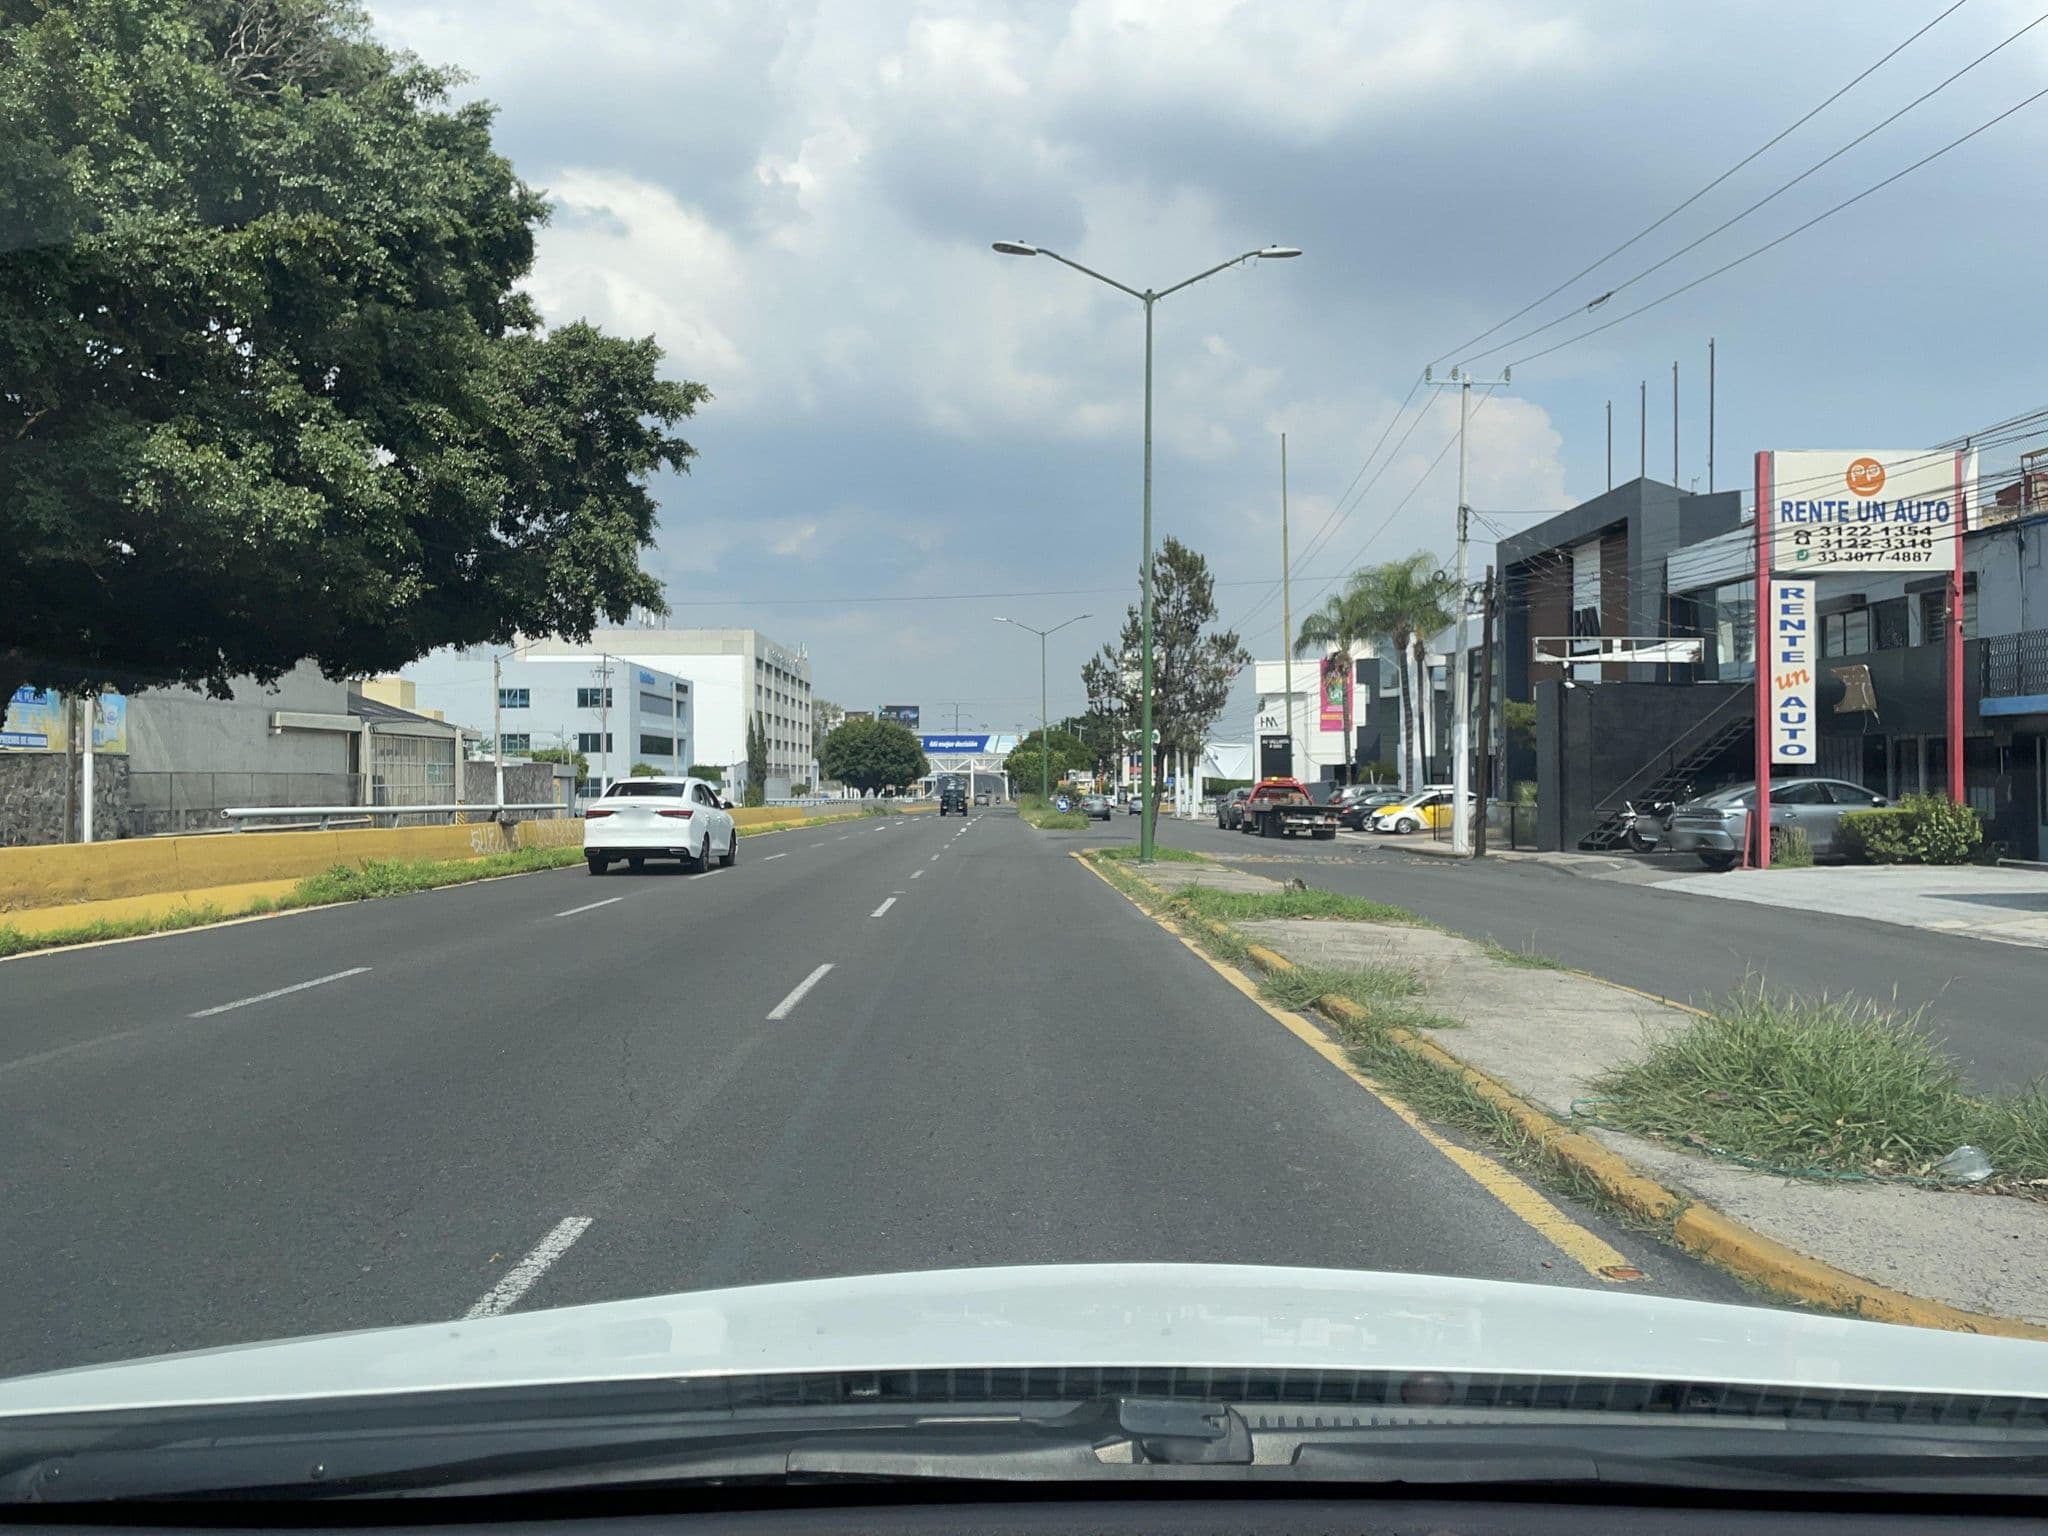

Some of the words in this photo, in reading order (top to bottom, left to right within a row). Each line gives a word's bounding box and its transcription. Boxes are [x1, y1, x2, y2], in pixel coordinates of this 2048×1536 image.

[1781, 500, 1849, 523] RENTE
[1857, 500, 1886, 523] UN
[1894, 500, 1950, 524] AUTO
[1820, 526, 1932, 537] 3122-1354
[1818, 551, 1932, 562] 33-3077-4887
[1779, 587, 1806, 663] RENTE
[1775, 668, 1810, 690] un
[1779, 696, 1807, 756] AUTO
